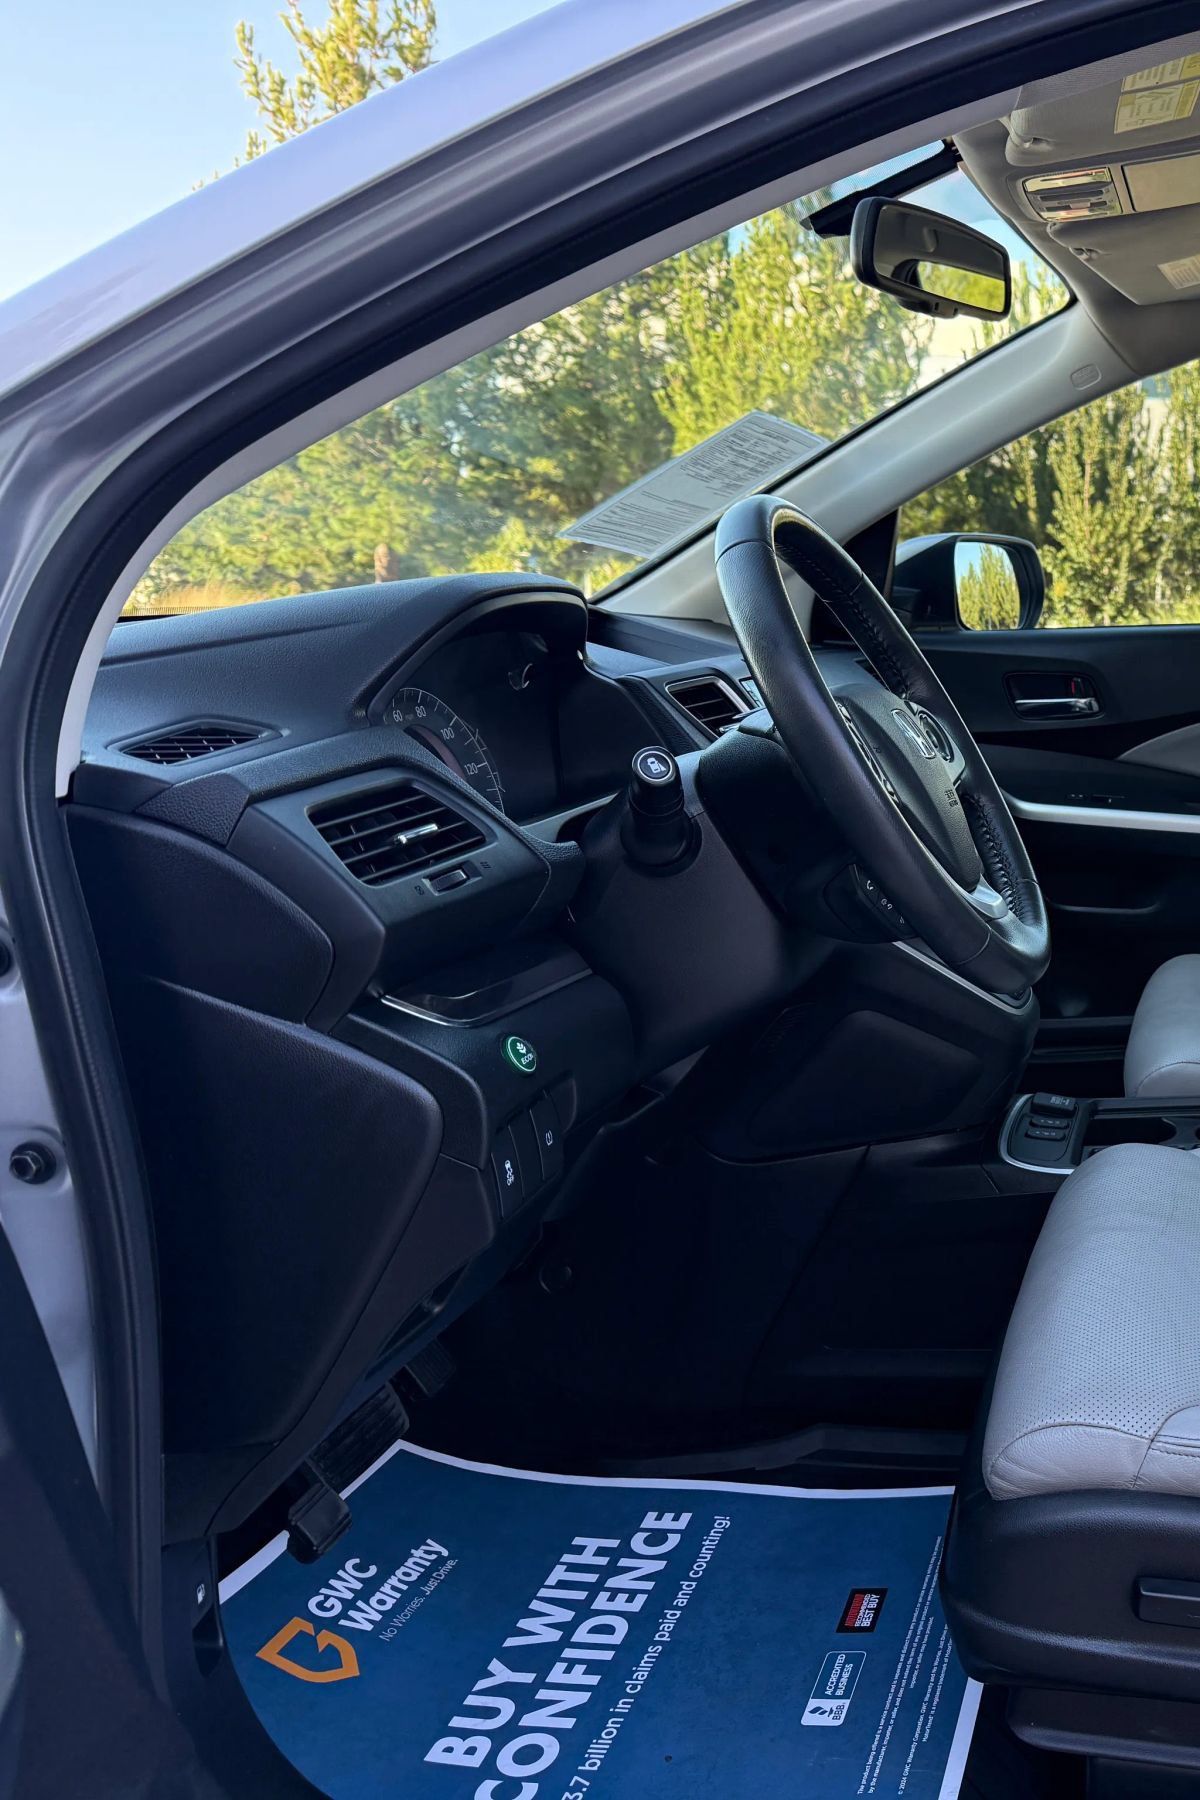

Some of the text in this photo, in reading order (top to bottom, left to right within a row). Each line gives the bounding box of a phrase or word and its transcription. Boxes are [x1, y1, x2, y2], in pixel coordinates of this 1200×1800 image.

[393, 710, 403, 722] 60
[415, 706, 426, 718] 80
[441, 728, 455, 740] 100
[464, 763, 479, 775] 120
[307, 1558, 377, 1617] GWC
[338, 1538, 449, 1631] Warranty
[379, 1557, 458, 1642] No Worries. Just Drive.
[861, 1594, 880, 1627] BEST BUY
[423, 1536, 621, 1768] BUY WITH
[474, 1511, 692, 1800] CONFIDENCE
[578, 1715, 624, 1771] billion
[610, 1698, 634, 1713] in
[625, 1644, 663, 1694] claims
[653, 1610, 682, 1642] paid
[673, 1581, 697, 1607] and
[689, 1515, 731, 1578] counting!
[825, 1653, 845, 1695] ACCREDITED
[835, 1663, 853, 1695] BUSINESS
[861, 1765, 870, 1784] product
[867, 1751, 875, 1764] being
[871, 1734, 880, 1751] offered
[879, 1710, 887, 1725] service
[884, 1692, 893, 1709] contract
[906, 1742, 916, 1762] Warranty
[873, 1745, 886, 1776] manufacturer,
